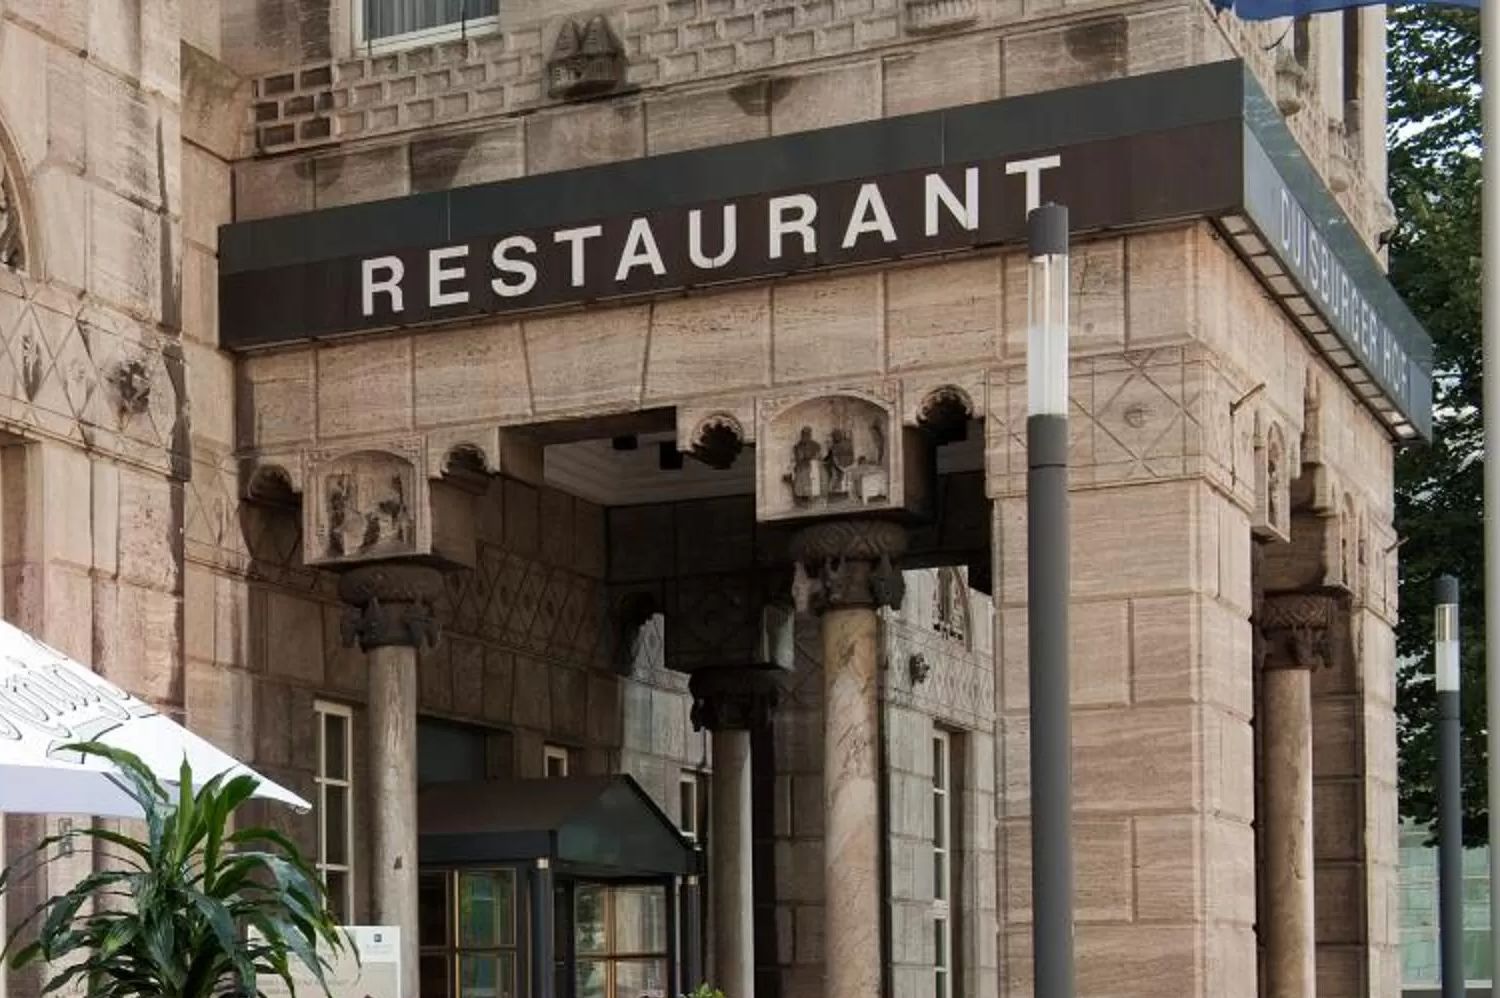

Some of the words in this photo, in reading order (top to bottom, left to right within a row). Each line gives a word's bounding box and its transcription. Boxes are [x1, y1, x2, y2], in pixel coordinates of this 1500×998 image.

[361, 155, 1063, 316] RESTAURANT
[1280, 187, 1379, 368] DUISBURGER
[1382, 326, 1408, 401] HOF
